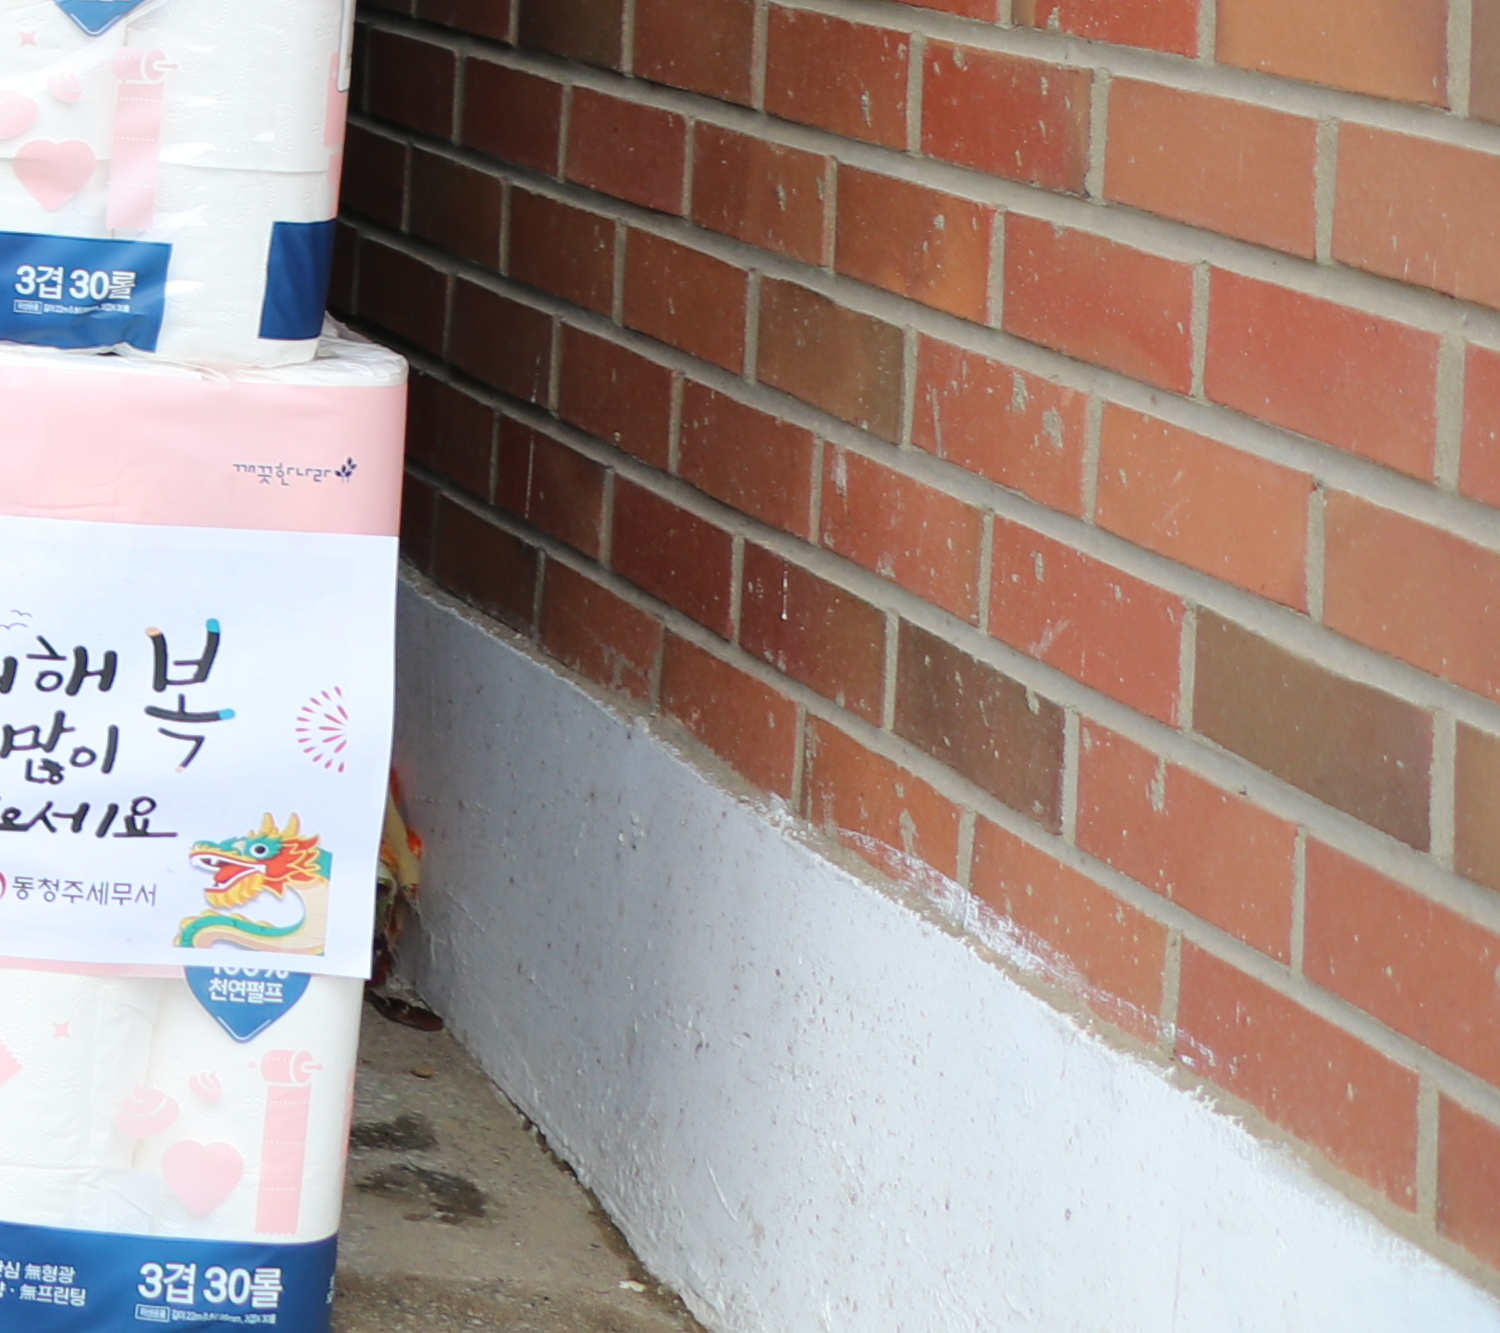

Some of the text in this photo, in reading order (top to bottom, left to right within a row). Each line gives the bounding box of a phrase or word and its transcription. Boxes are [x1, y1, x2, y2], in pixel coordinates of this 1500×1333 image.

[14, 264, 138, 302] 3겹 30롤
[145, 618, 236, 774] 복
[12, 875, 158, 910] 동청주세무서
[208, 977, 284, 1004] 천연펄프
[136, 1262, 196, 1305] 3겹
[203, 1266, 284, 1310] 30롤
